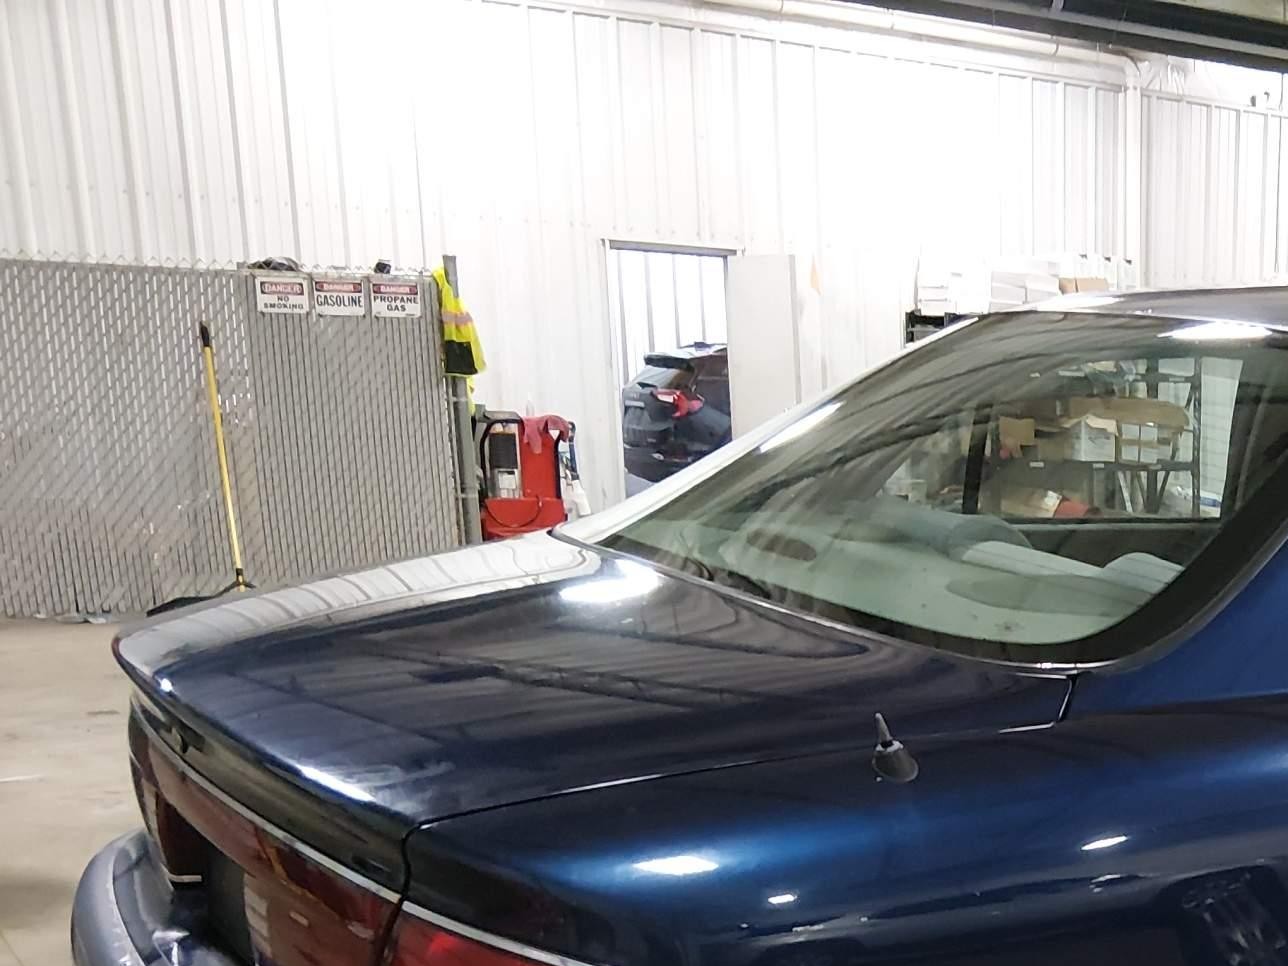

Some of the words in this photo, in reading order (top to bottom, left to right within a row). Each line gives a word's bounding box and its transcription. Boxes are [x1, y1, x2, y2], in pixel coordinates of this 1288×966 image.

[264, 282, 301, 294] DANGER
[316, 294, 363, 308] GASOLINE
[373, 295, 419, 304] PROPANE
[263, 302, 304, 310] SMOKING
[387, 304, 406, 312] GAS
